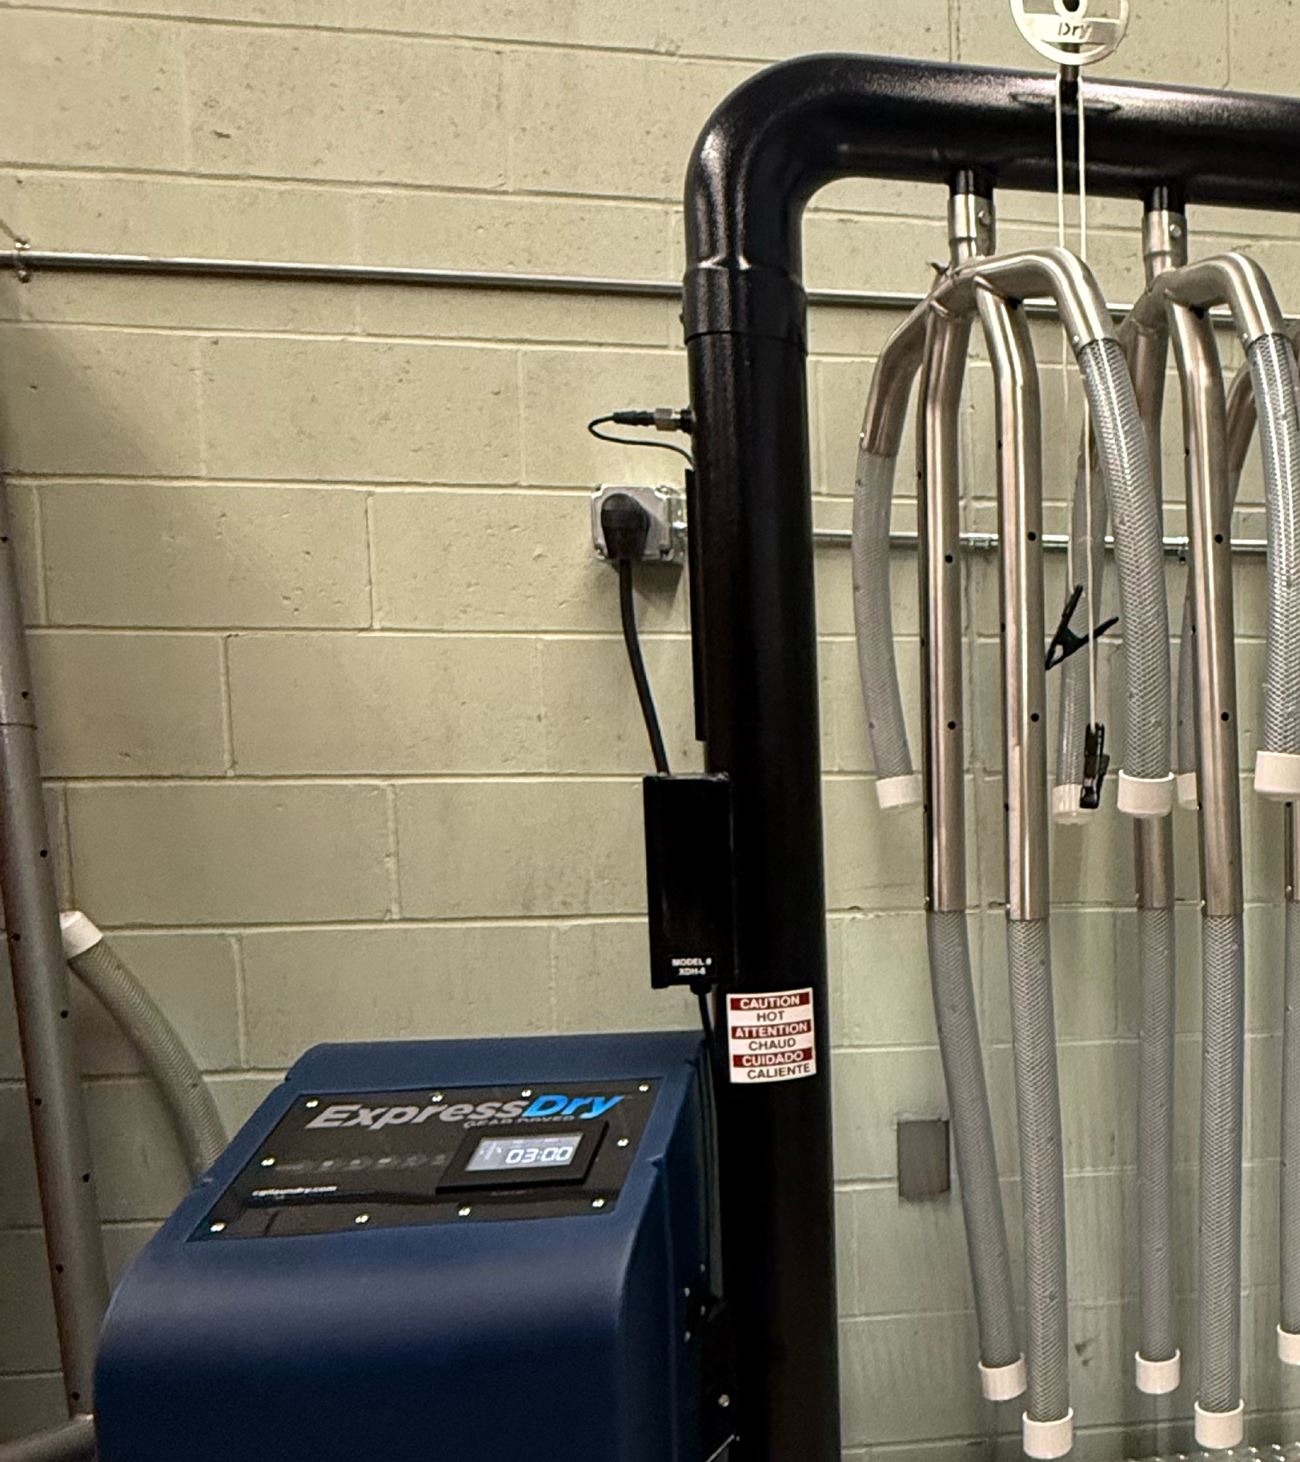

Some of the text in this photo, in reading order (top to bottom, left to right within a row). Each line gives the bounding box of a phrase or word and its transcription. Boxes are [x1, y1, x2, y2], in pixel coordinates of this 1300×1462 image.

[1058, 22, 1091, 39] Dry
[672, 958, 704, 967] MODEL
[740, 995, 800, 1009] CAUTION
[757, 1011, 785, 1022] HOT
[736, 1022, 807, 1037] ATTENTION
[748, 1037, 796, 1051] CHAUD
[742, 1051, 804, 1066] CUIDADO
[747, 1063, 811, 1079] CALIENTE
[305, 1095, 624, 1130] ExpressDry
[505, 1146, 574, 1164] 03:00
